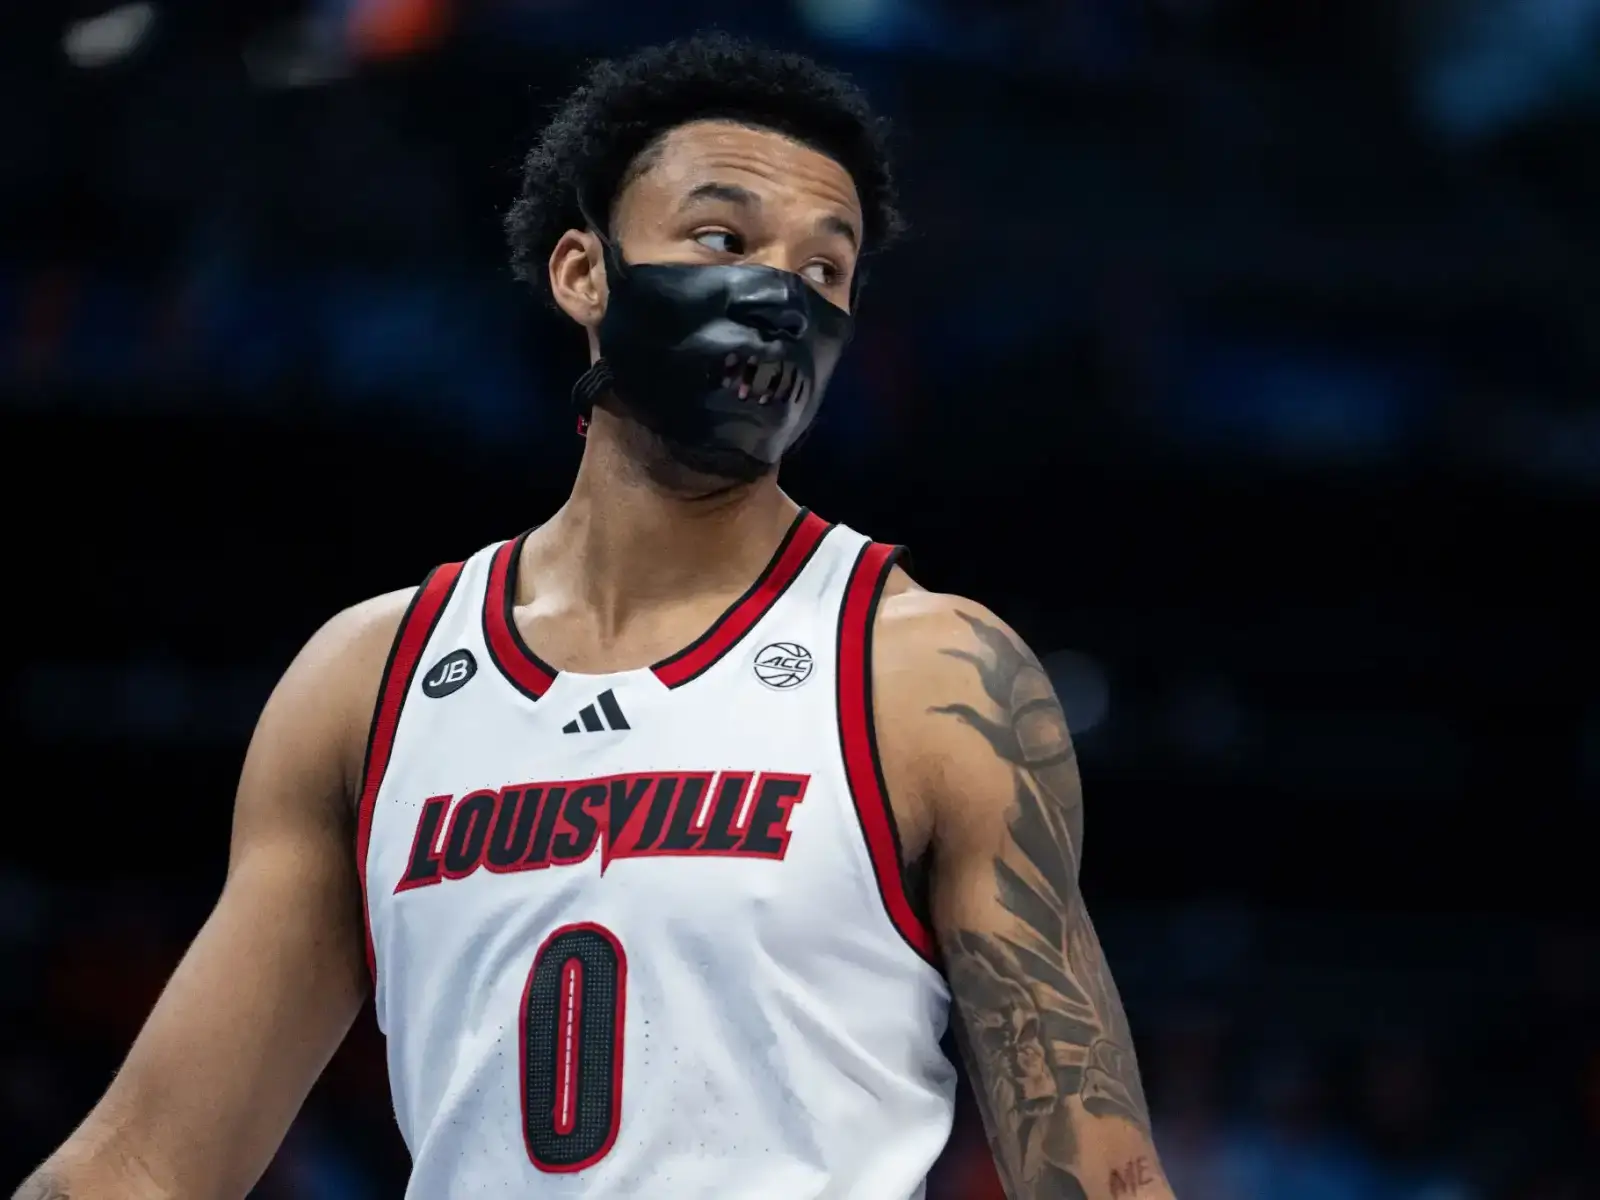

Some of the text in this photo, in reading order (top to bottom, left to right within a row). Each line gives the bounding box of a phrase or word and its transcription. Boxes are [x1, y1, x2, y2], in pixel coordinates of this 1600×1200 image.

[429, 659, 468, 687] JB
[761, 656, 812, 670] ACC
[393, 771, 811, 895] LOUISVILLE
[519, 922, 627, 1173] 0
